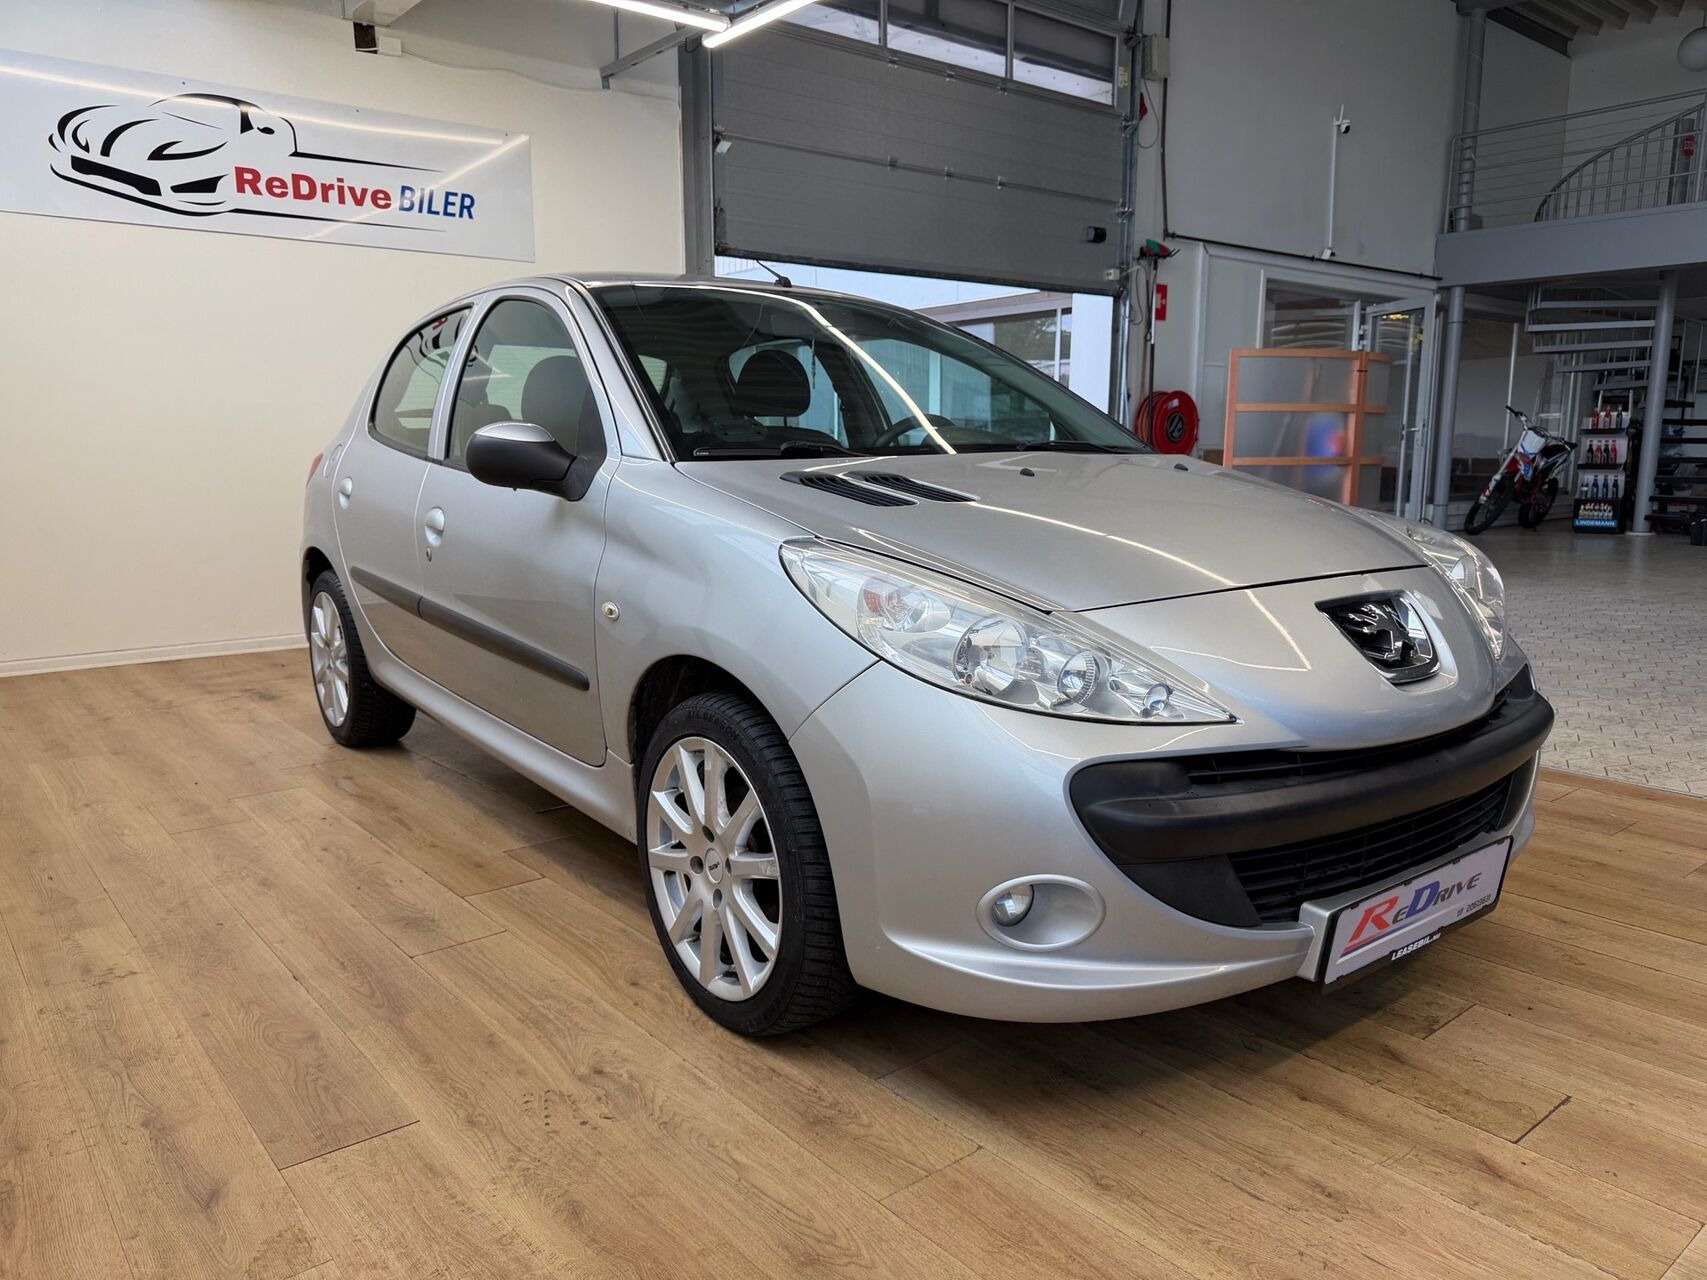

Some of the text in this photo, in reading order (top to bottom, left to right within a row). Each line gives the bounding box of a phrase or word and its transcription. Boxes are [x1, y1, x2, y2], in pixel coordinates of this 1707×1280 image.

[234, 166, 476, 220] ReDrive BILER
[1575, 519, 1615, 527] LINDEMANN
